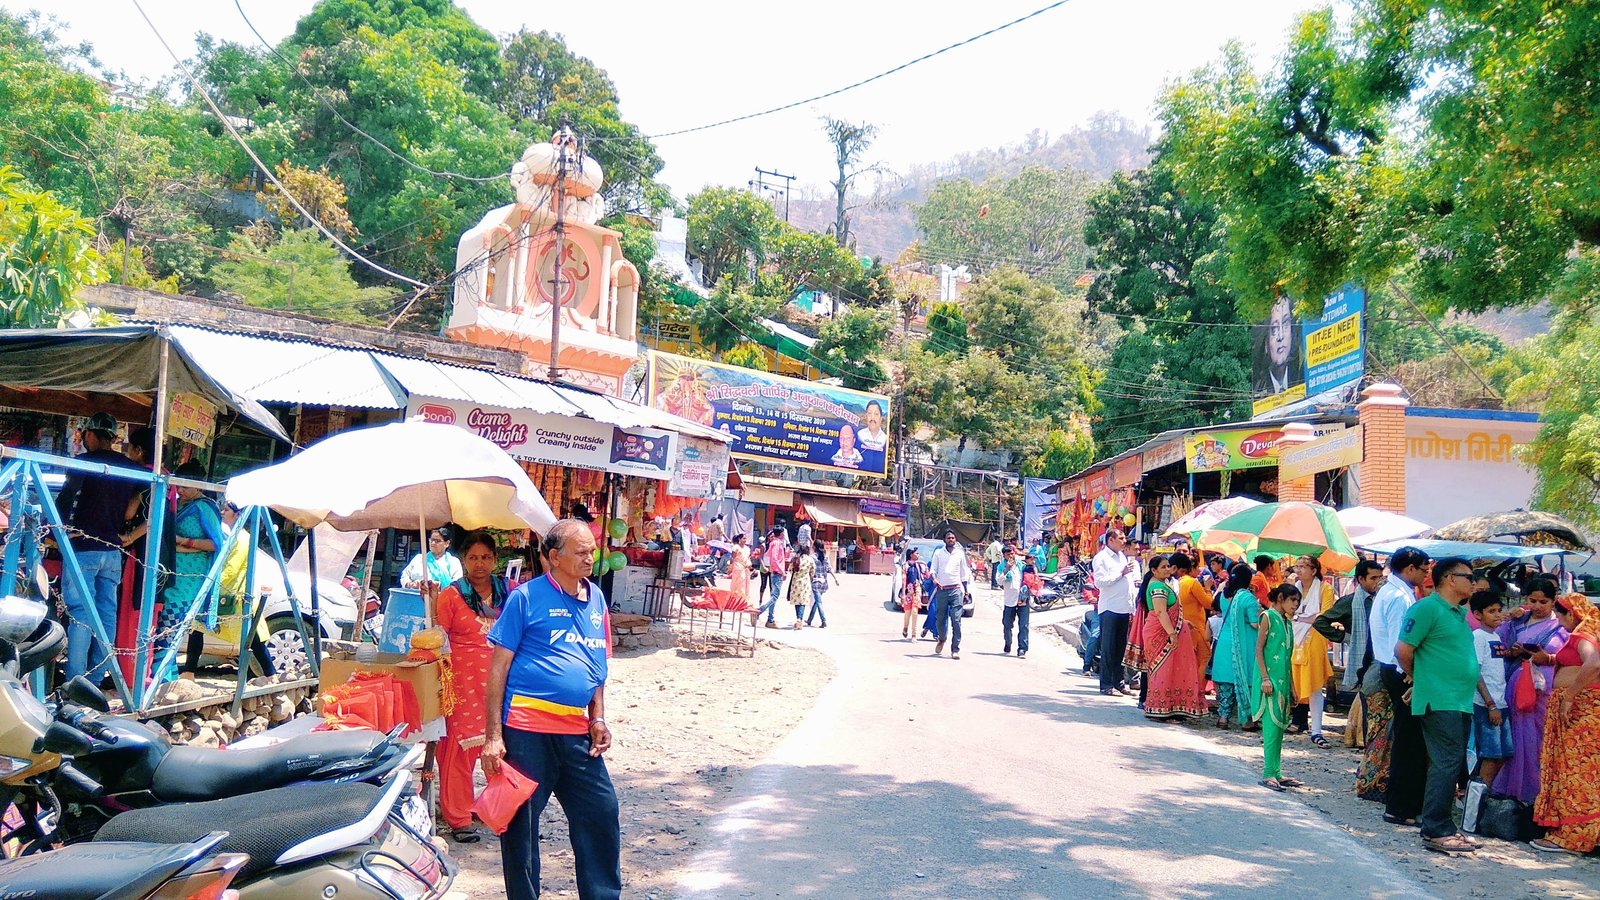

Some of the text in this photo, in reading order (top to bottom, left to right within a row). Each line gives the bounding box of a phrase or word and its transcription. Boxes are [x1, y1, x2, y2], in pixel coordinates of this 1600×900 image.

[1337, 317, 1355, 333] NEET
[705, 385, 719, 401] श्री
[423, 407, 452, 422] bonn
[468, 409, 509, 427] Creme
[732, 401, 754, 413] दिनांक
[781, 412, 788, 420] 15
[813, 416, 826, 426] 2019
[480, 424, 527, 447] Delight
[536, 428, 605, 445] Crunchy outside
[538, 437, 597, 452] Creamy inside
[797, 441, 810, 451] 2019
[1465, 431, 1512, 463] गिरी
[538, 456, 565, 466] CENTER
[334, 772, 359, 784] 150
